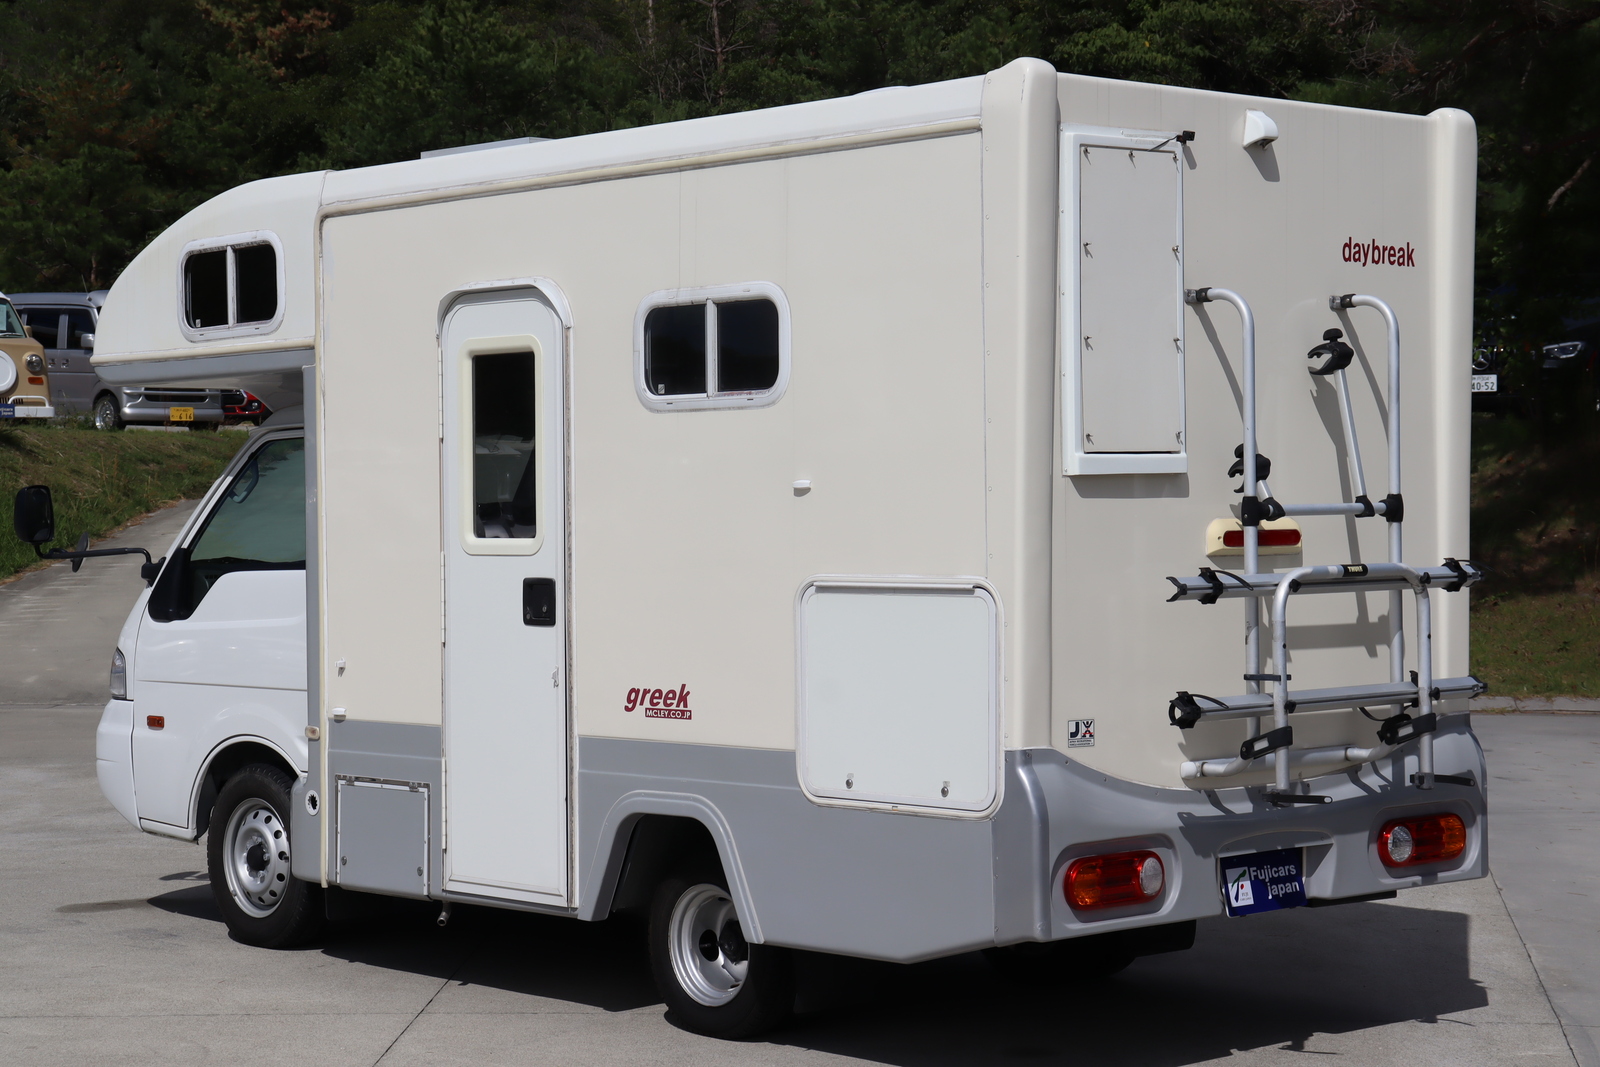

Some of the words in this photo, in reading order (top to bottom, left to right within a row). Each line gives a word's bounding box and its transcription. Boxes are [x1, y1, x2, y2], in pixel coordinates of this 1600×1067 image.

[1342, 236, 1416, 268] daybreak
[624, 683, 691, 713] greek
[645, 708, 692, 720] MCLEY.CO.JP
[1249, 864, 1297, 883] Fujicars
[1267, 881, 1300, 900] japan
